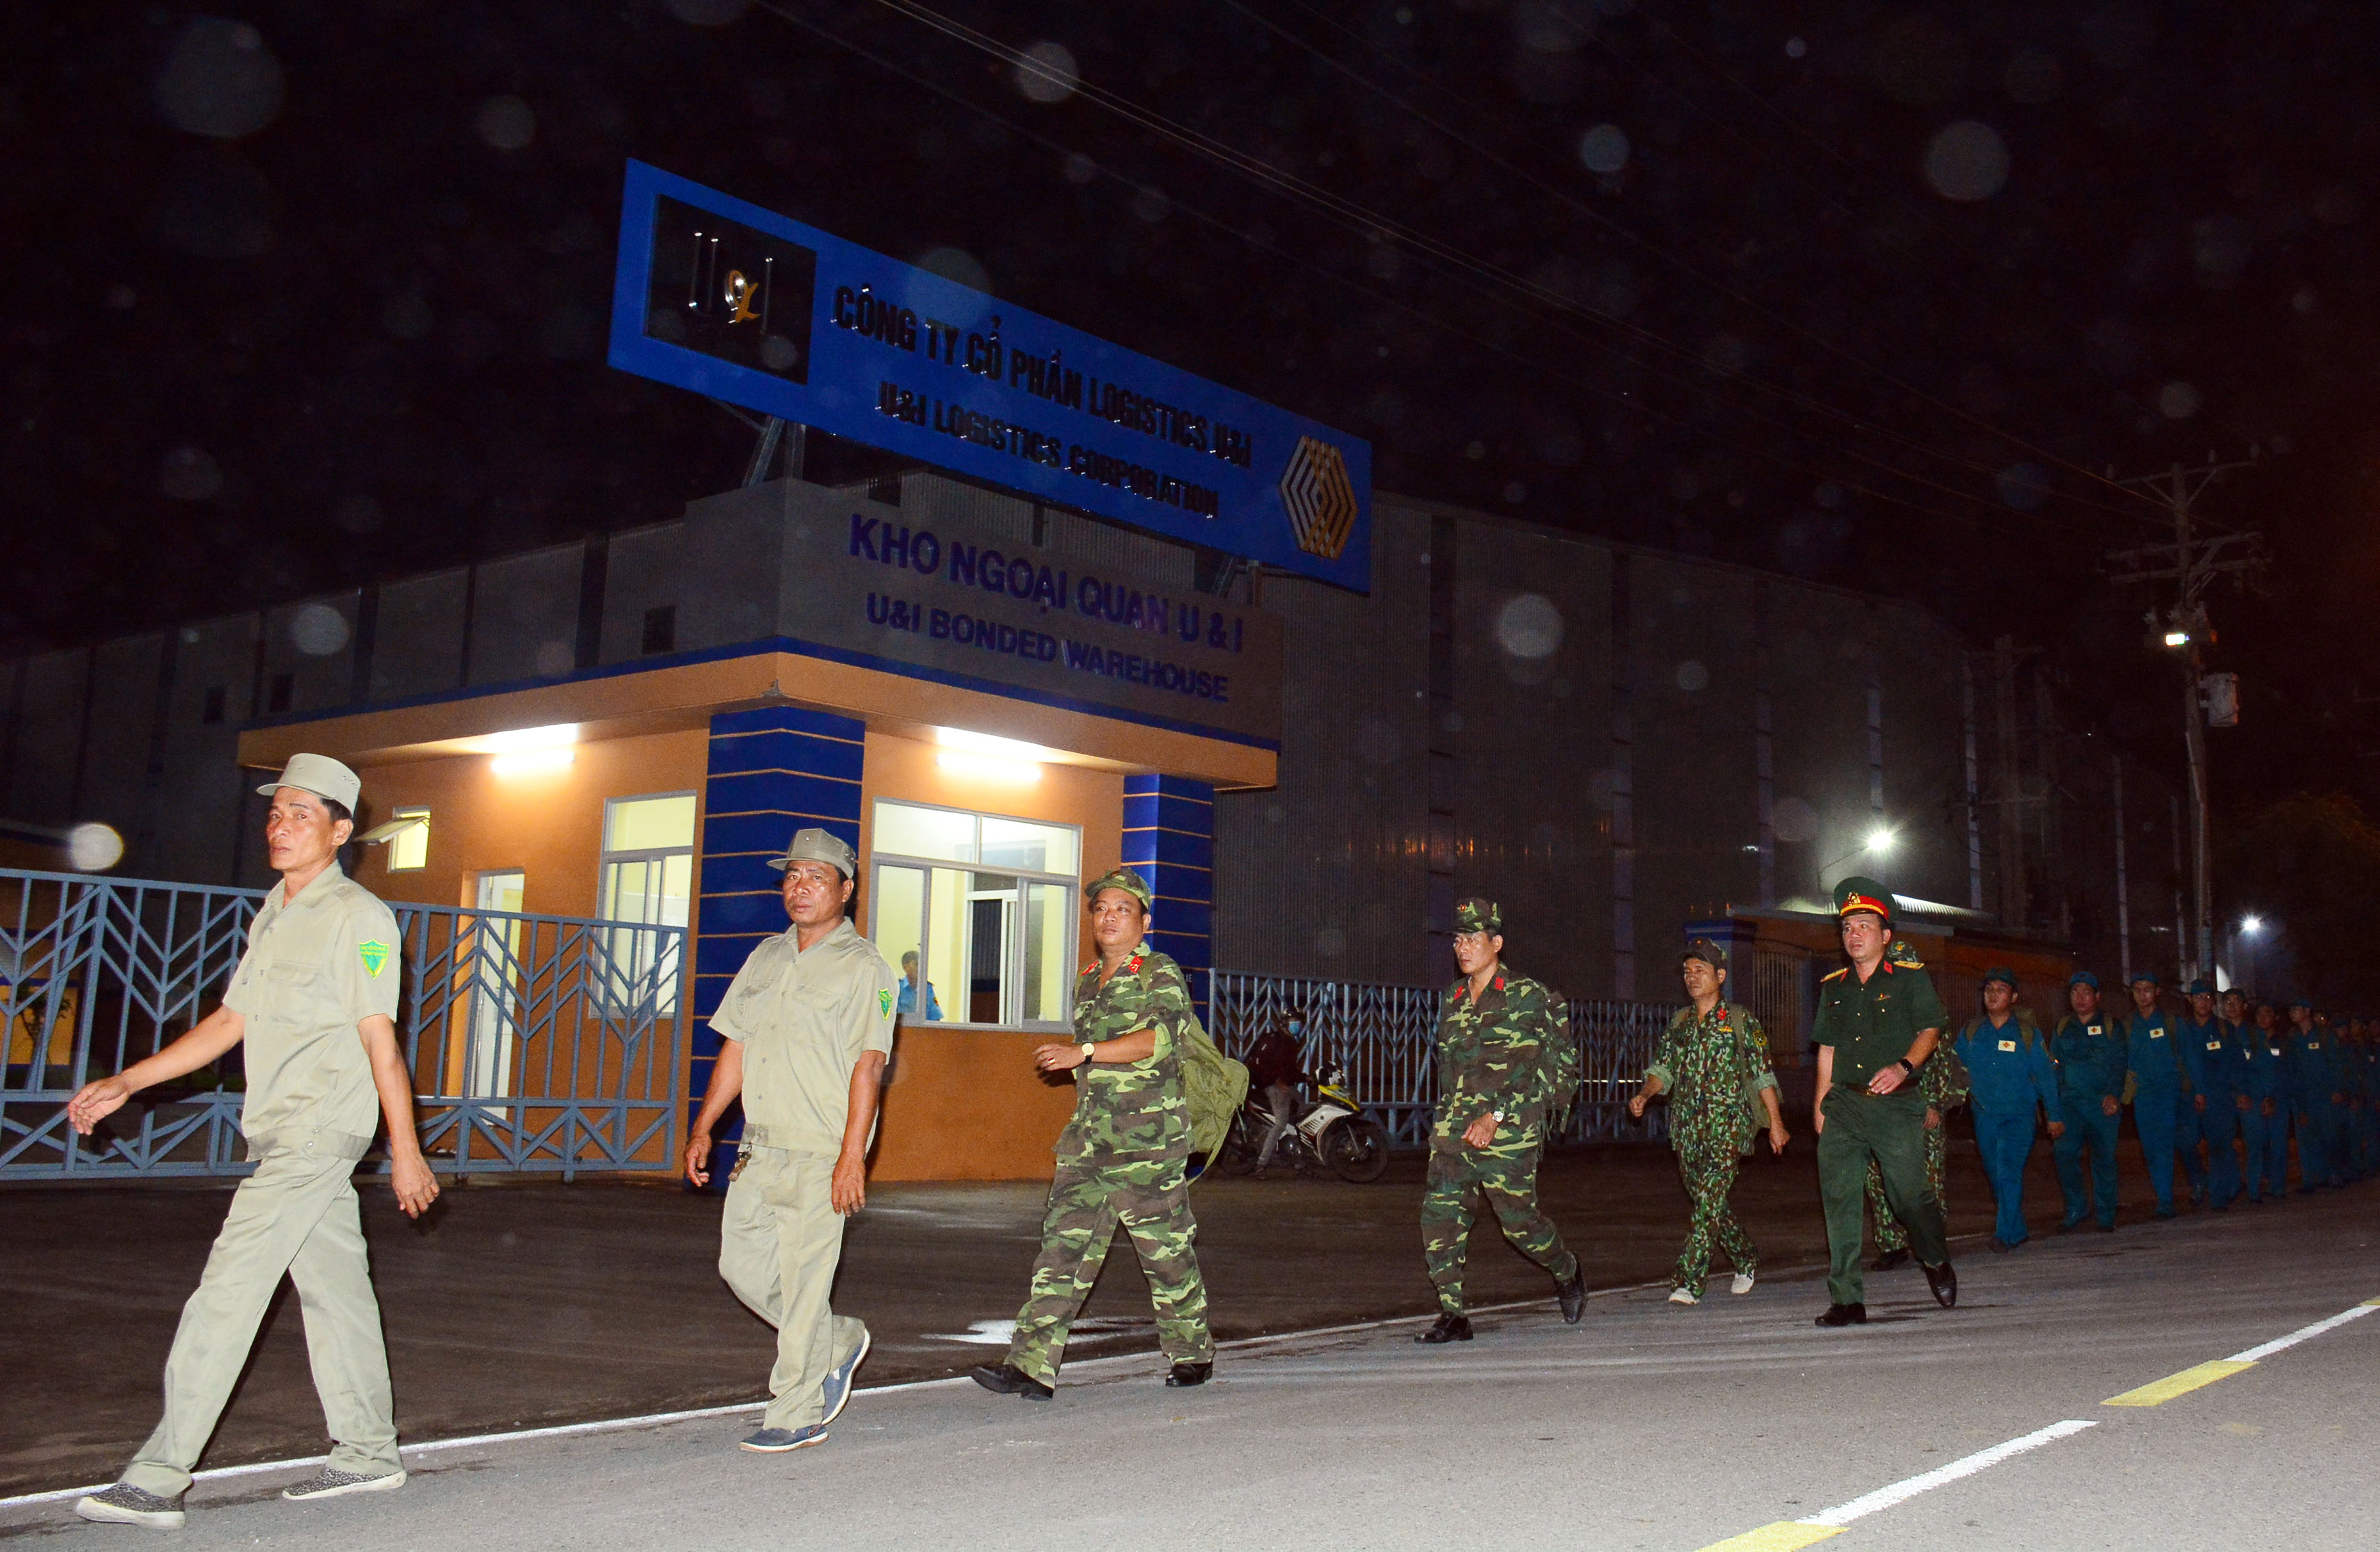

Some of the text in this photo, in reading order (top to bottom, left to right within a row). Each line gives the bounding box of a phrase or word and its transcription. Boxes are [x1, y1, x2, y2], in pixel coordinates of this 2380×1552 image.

[834, 283, 916, 352] CÔNG
[926, 318, 959, 366] TY
[966, 315, 1002, 380] CỔ
[1090, 378, 1207, 453] LOGISTICS
[1214, 423, 1252, 469] U&I
[878, 382, 1219, 519] U&I LOGISTICS CORPORATION
[850, 513, 1243, 654] KHO NGOẠI QUAN U & I
[867, 592, 1229, 702] U&I BONDED WAREHOUSE
